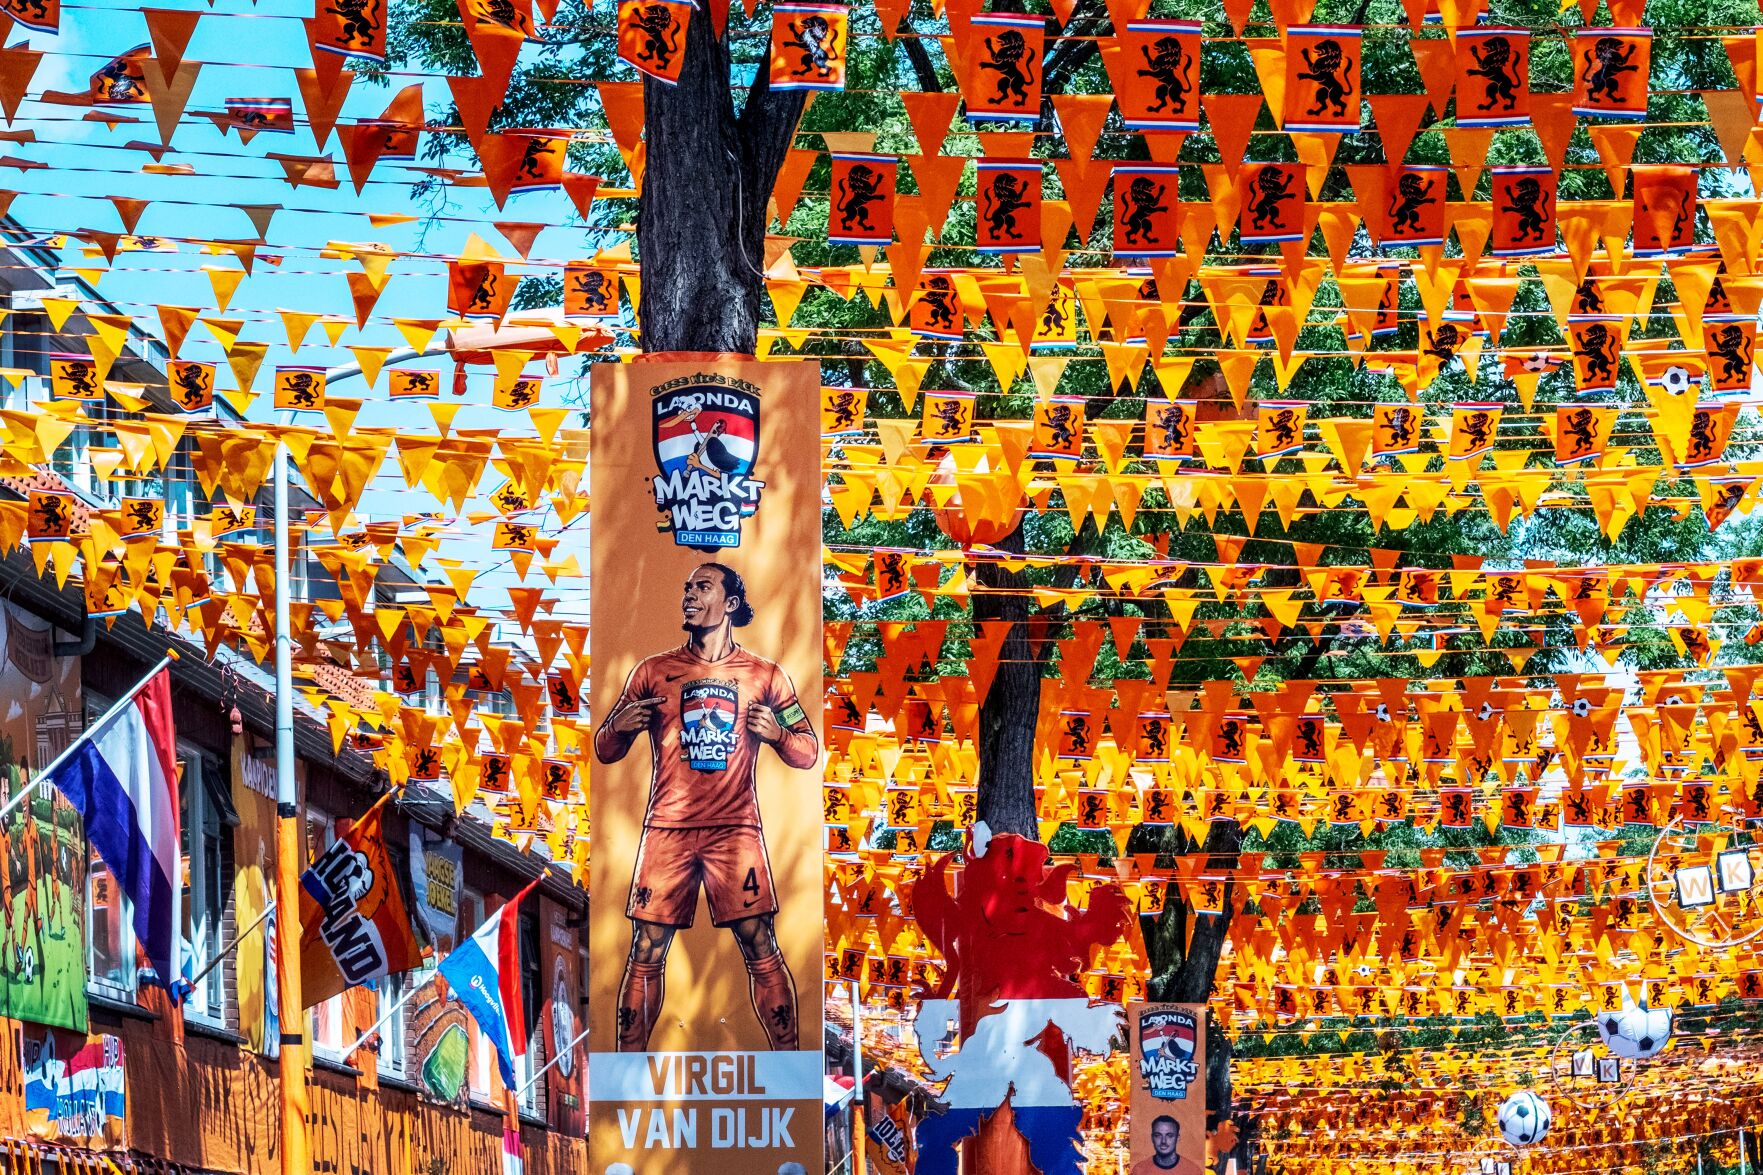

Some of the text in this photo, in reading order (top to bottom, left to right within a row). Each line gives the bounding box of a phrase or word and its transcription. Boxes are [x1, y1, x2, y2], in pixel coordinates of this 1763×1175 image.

[654, 469, 765, 503] MARKT
[672, 497, 738, 531] WEG
[681, 533, 735, 544] DEN HAAG
[680, 727, 740, 744] MARKT
[689, 742, 726, 761] WEG
[743, 867, 760, 897] 4
[647, 1055, 766, 1095] VIRGIL
[1140, 1056, 1200, 1075] MARKT
[1149, 1072, 1186, 1090] WEG
[617, 1107, 796, 1149] VAN DIJK
